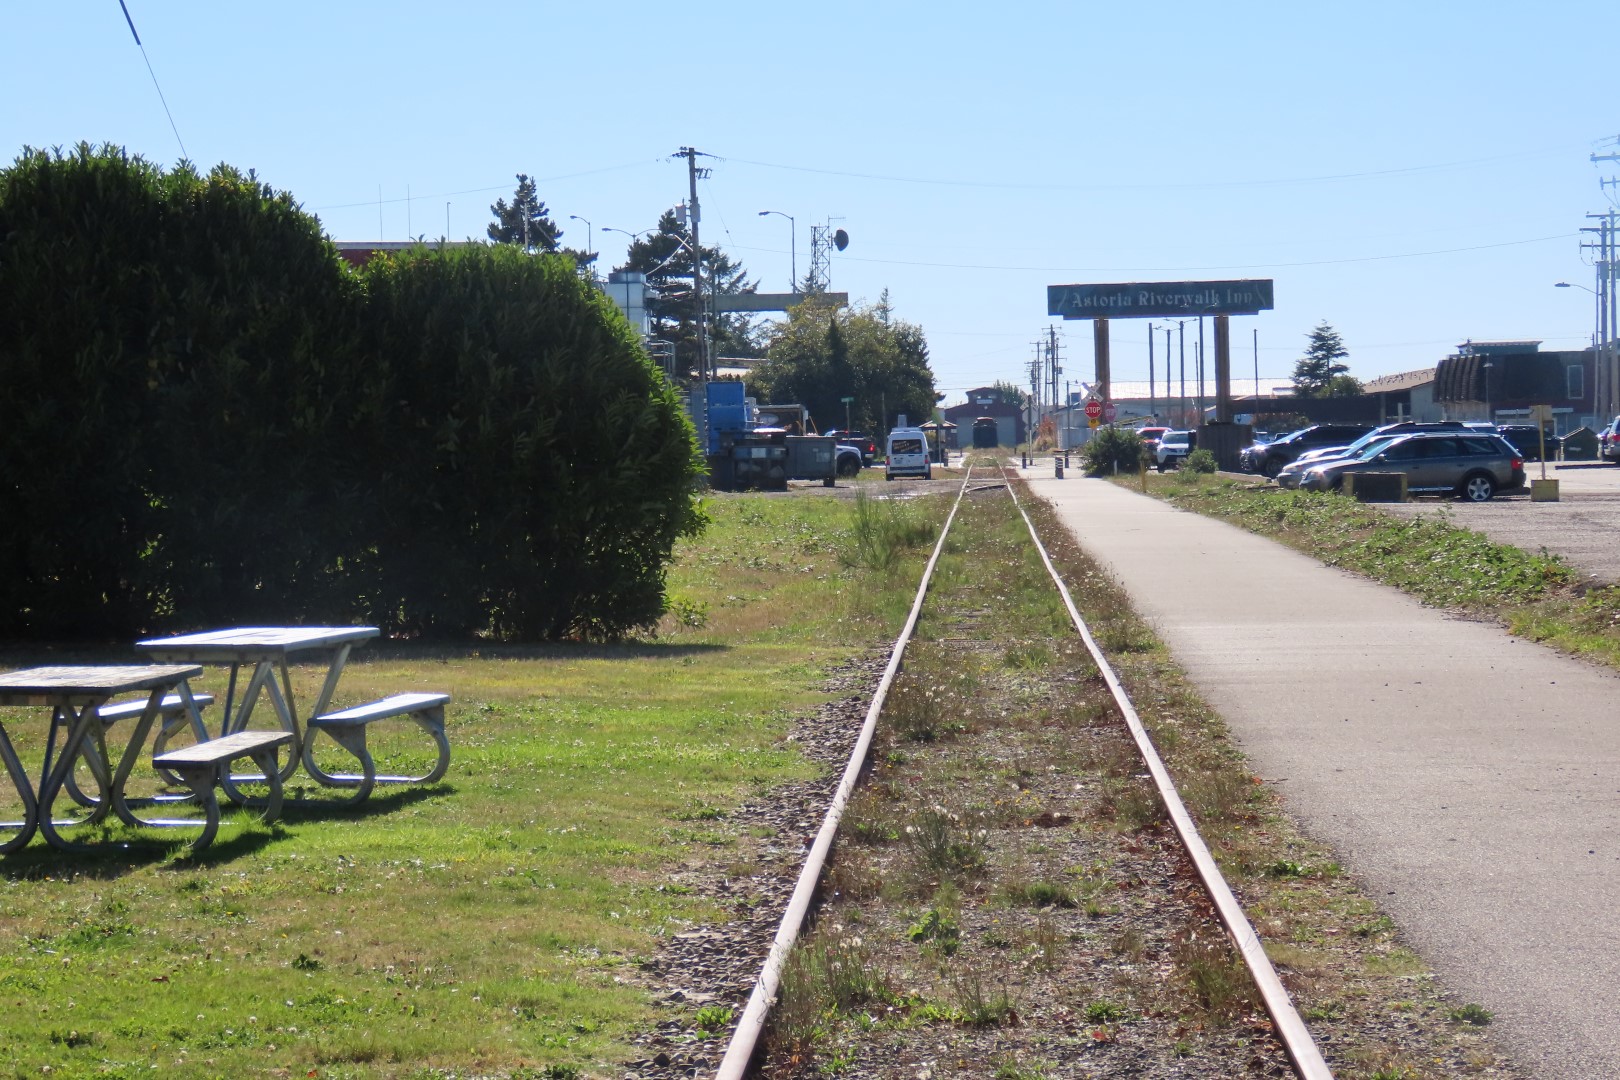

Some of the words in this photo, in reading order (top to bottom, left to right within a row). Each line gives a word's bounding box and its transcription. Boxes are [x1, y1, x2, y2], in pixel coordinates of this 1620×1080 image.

[1072, 292, 1131, 308] Astoria
[1139, 290, 1219, 306] Riverwalk
[1227, 289, 1252, 305] Inn
